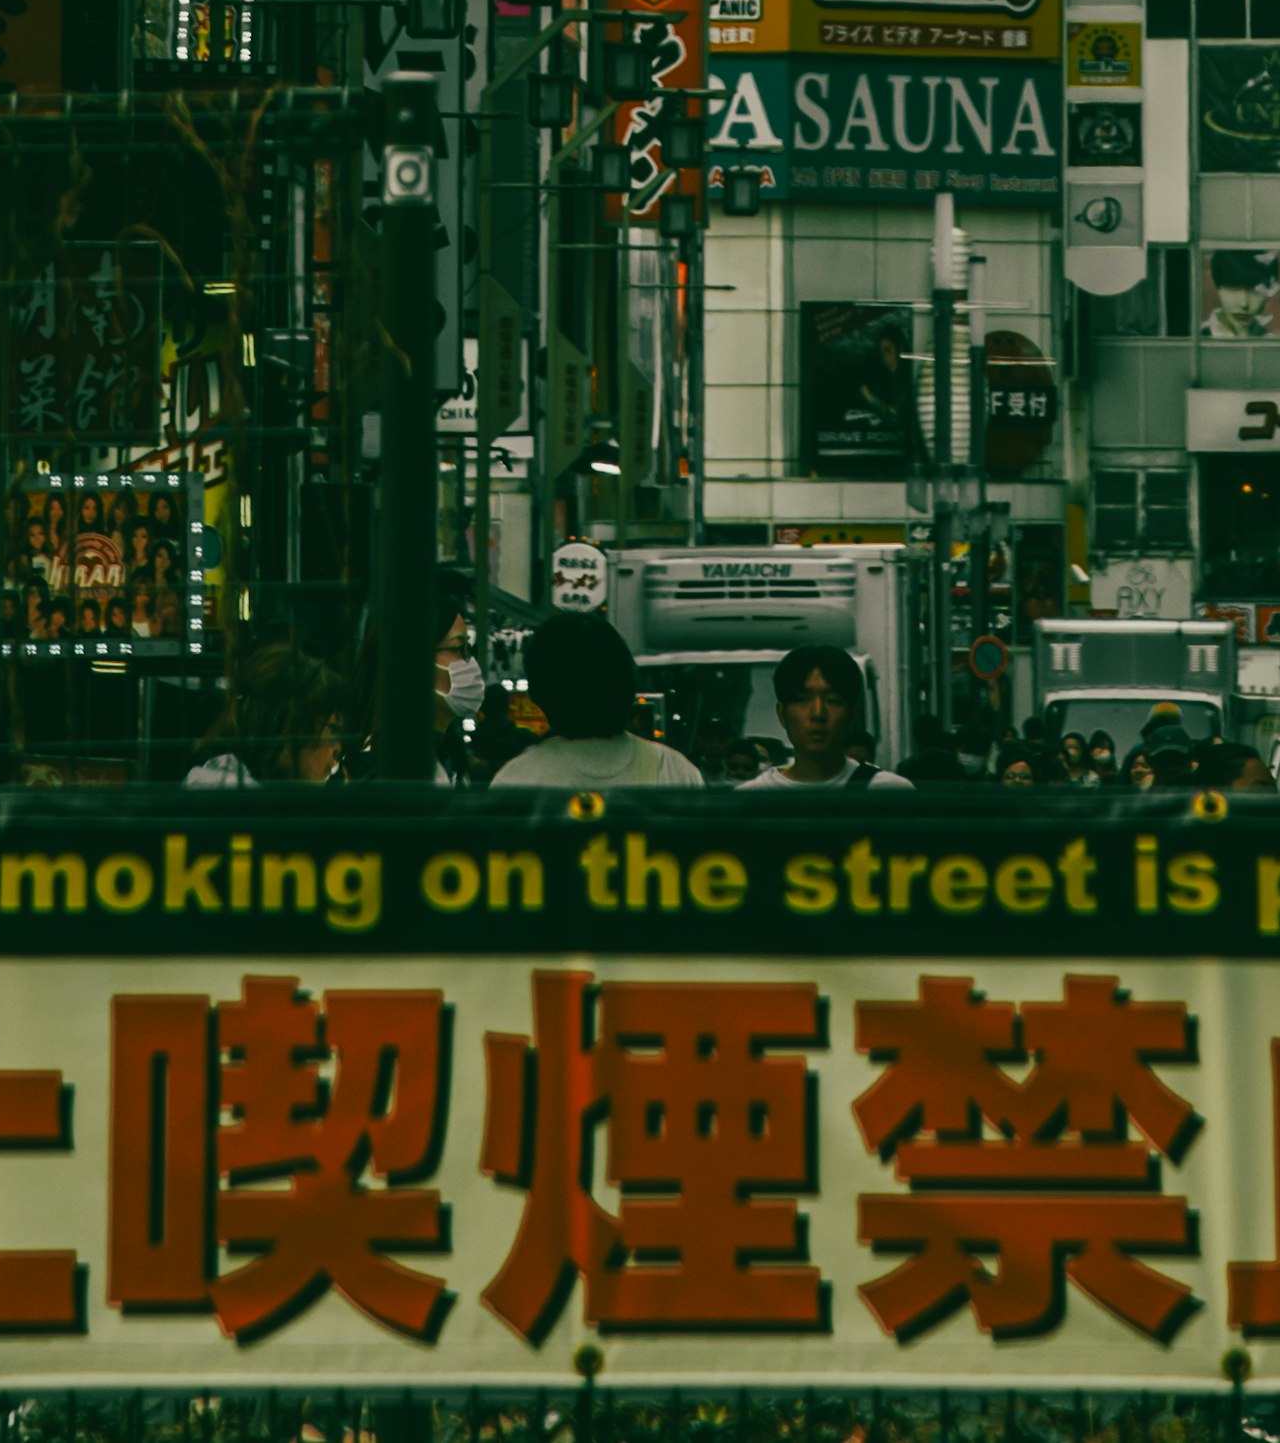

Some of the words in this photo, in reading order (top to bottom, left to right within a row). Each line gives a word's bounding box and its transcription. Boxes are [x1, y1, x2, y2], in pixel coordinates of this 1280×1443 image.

[822, 23, 875, 45] プライズ
[882, 26, 923, 47] ビデオ
[929, 27, 995, 49] アーケード
[793, 71, 1057, 157] SAUNA
[702, 562, 792, 579] YAMAICHI
[422, 839, 546, 912] on
[580, 834, 749, 912] the
[782, 834, 1099, 913] street
[1134, 834, 1222, 913] is
